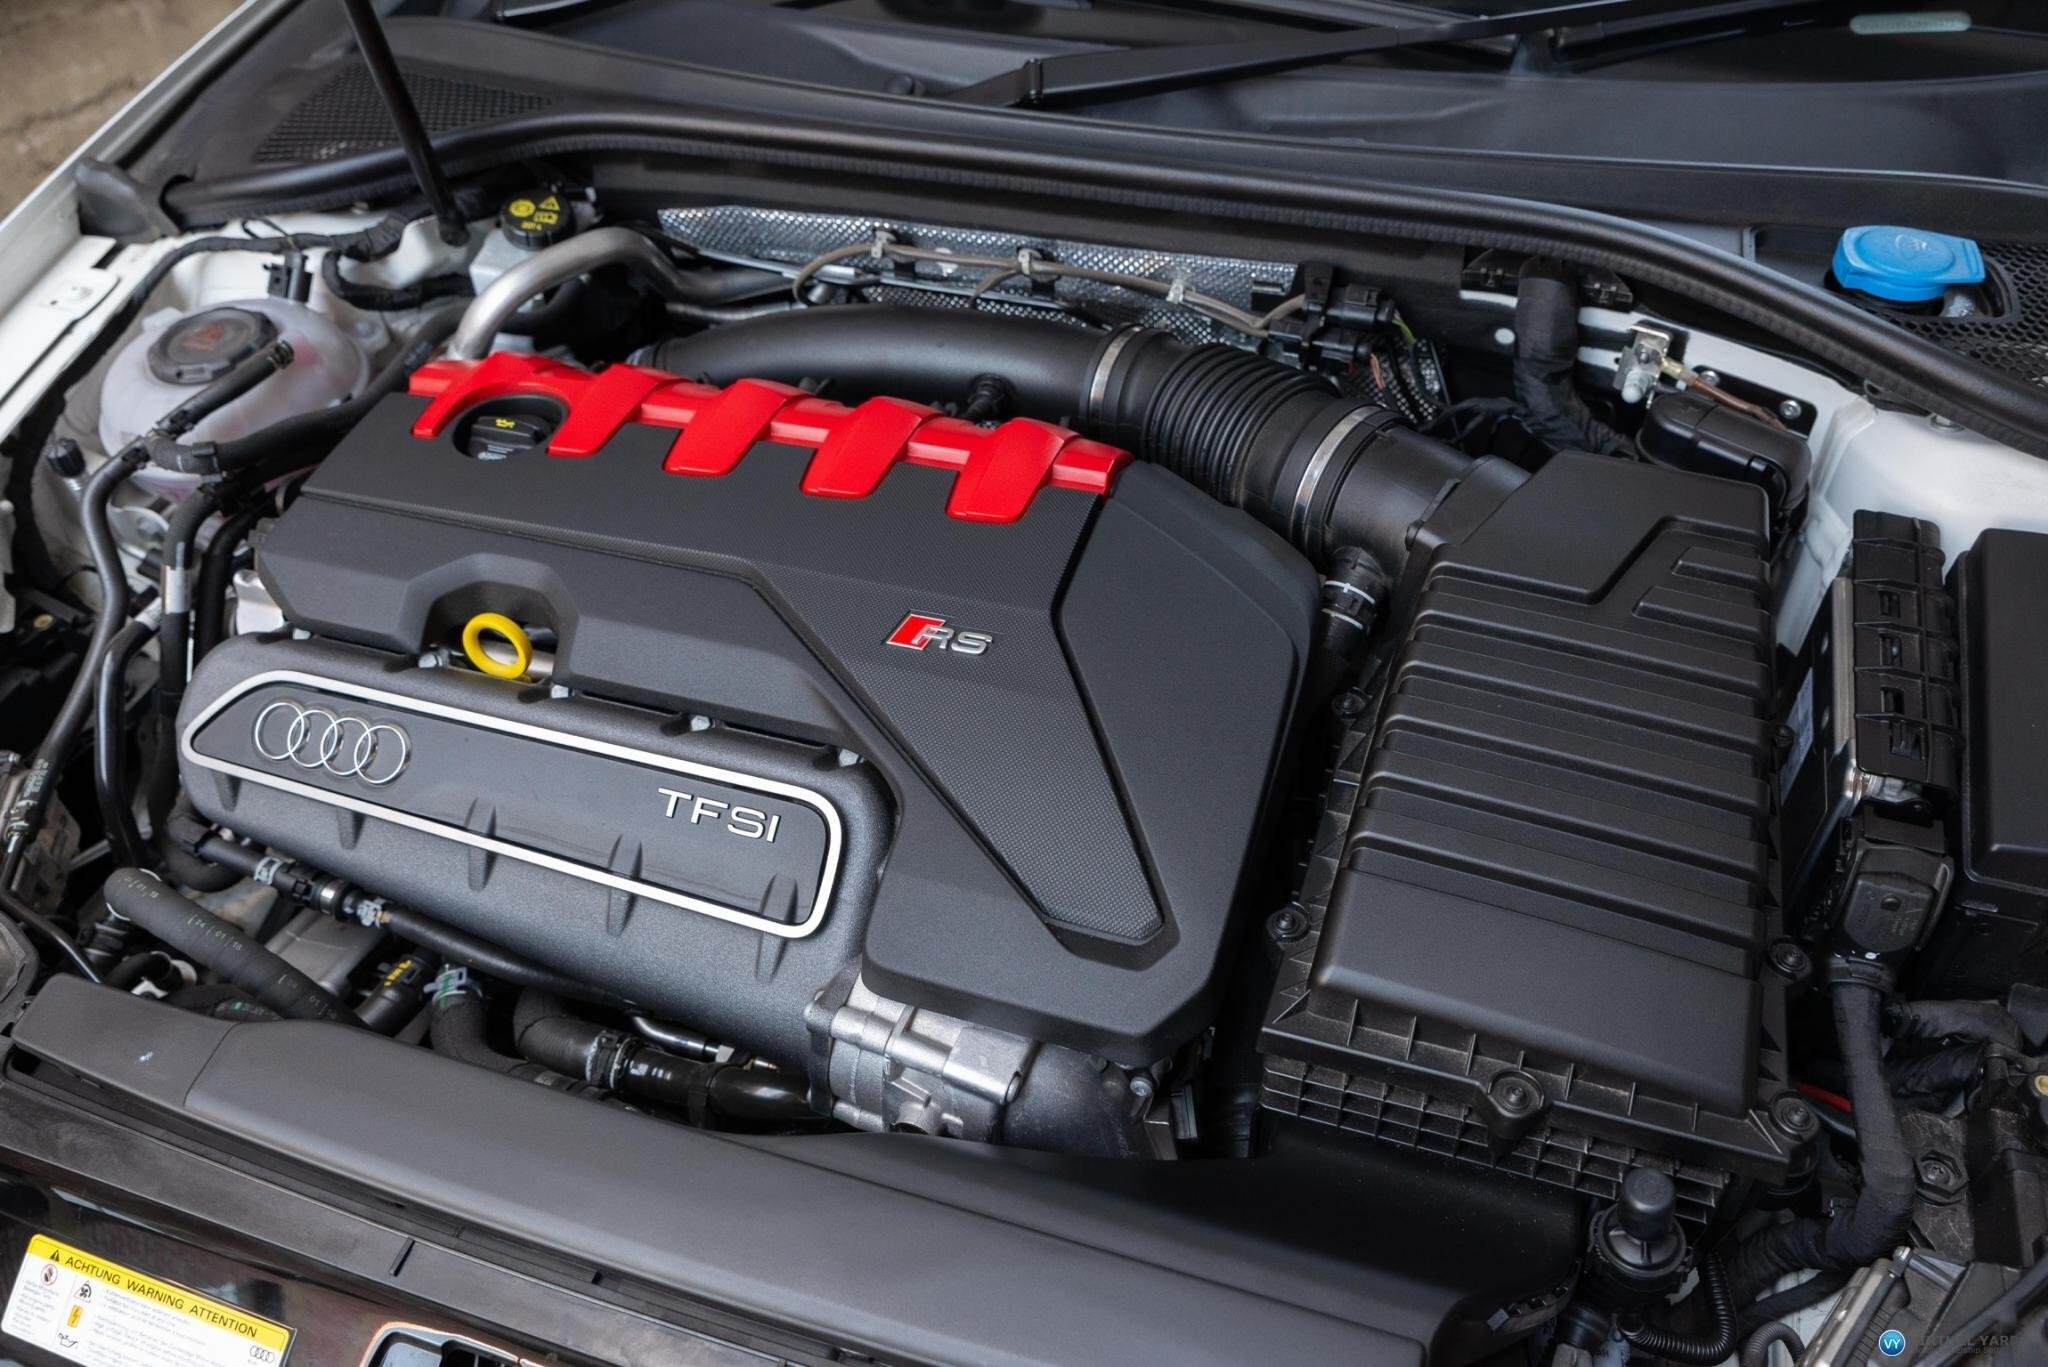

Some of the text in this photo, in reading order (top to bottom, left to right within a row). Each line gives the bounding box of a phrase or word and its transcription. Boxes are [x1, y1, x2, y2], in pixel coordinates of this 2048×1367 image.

[911, 624, 993, 655] RS
[658, 787, 780, 843] TFSI
[65, 1257, 121, 1285] ACHTUNG
[126, 1279, 185, 1310] WARNING
[189, 1305, 258, 1338] ATTENTION
